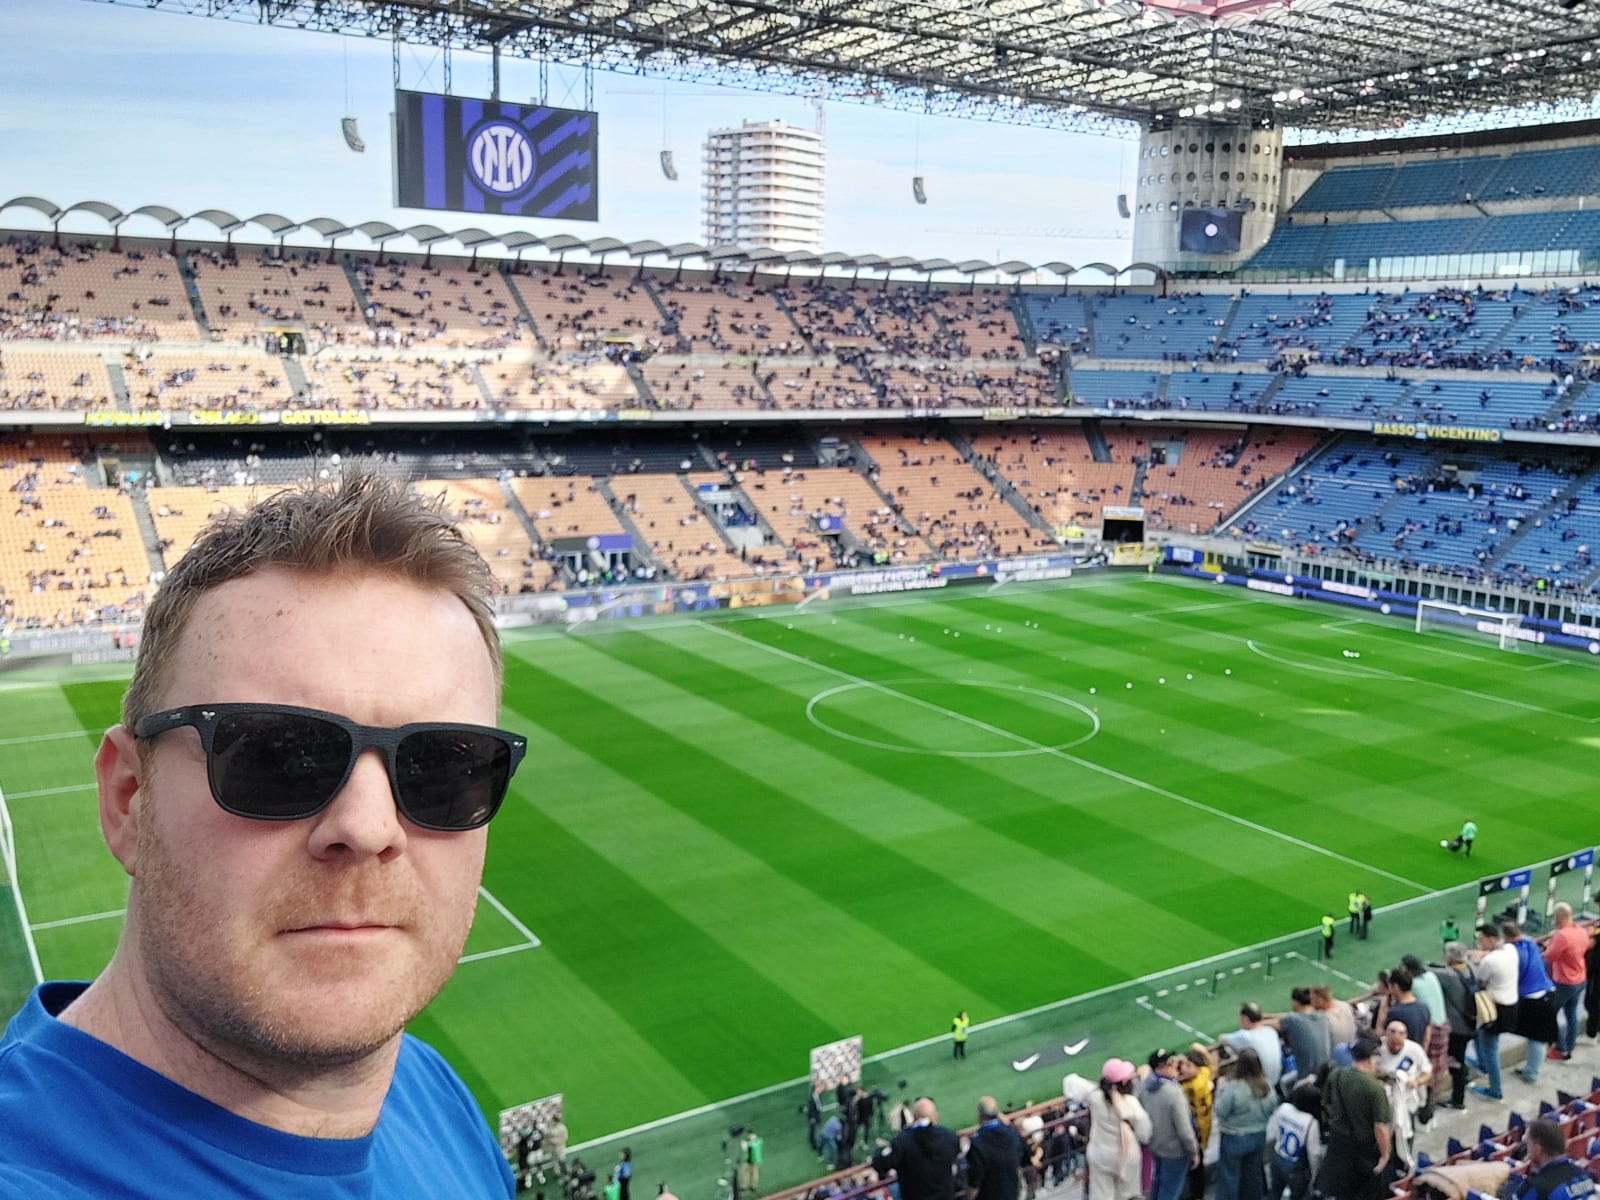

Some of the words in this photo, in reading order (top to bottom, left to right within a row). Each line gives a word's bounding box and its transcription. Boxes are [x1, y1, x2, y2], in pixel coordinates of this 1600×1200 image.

[281, 409, 369, 424] CATTOLICA
[1374, 421, 1415, 436] BASSO
[1427, 425, 1501, 441] VICENTINO
